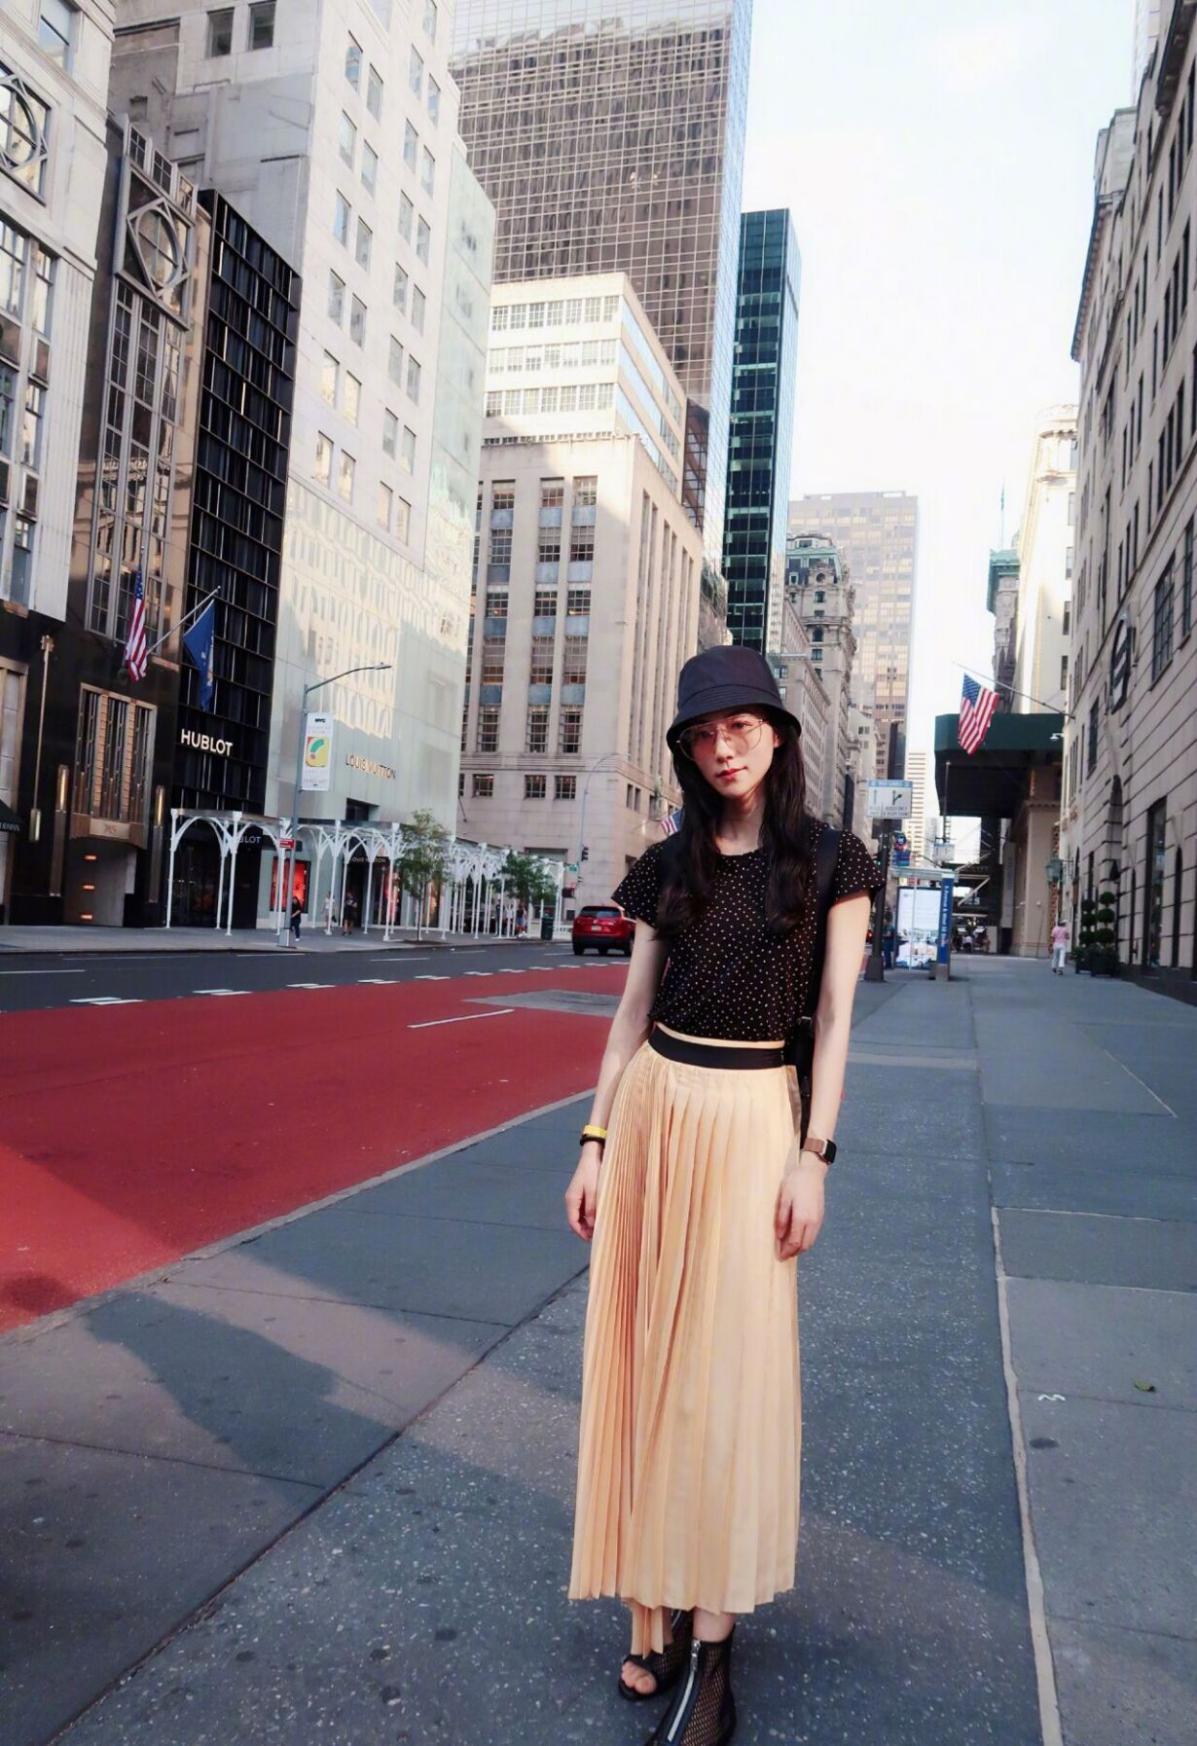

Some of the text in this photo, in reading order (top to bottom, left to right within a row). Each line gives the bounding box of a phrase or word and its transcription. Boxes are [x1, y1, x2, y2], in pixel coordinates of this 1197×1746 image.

[181, 728, 234, 757] HUBLOT
[345, 753, 397, 780] LOUIS VUITTON
